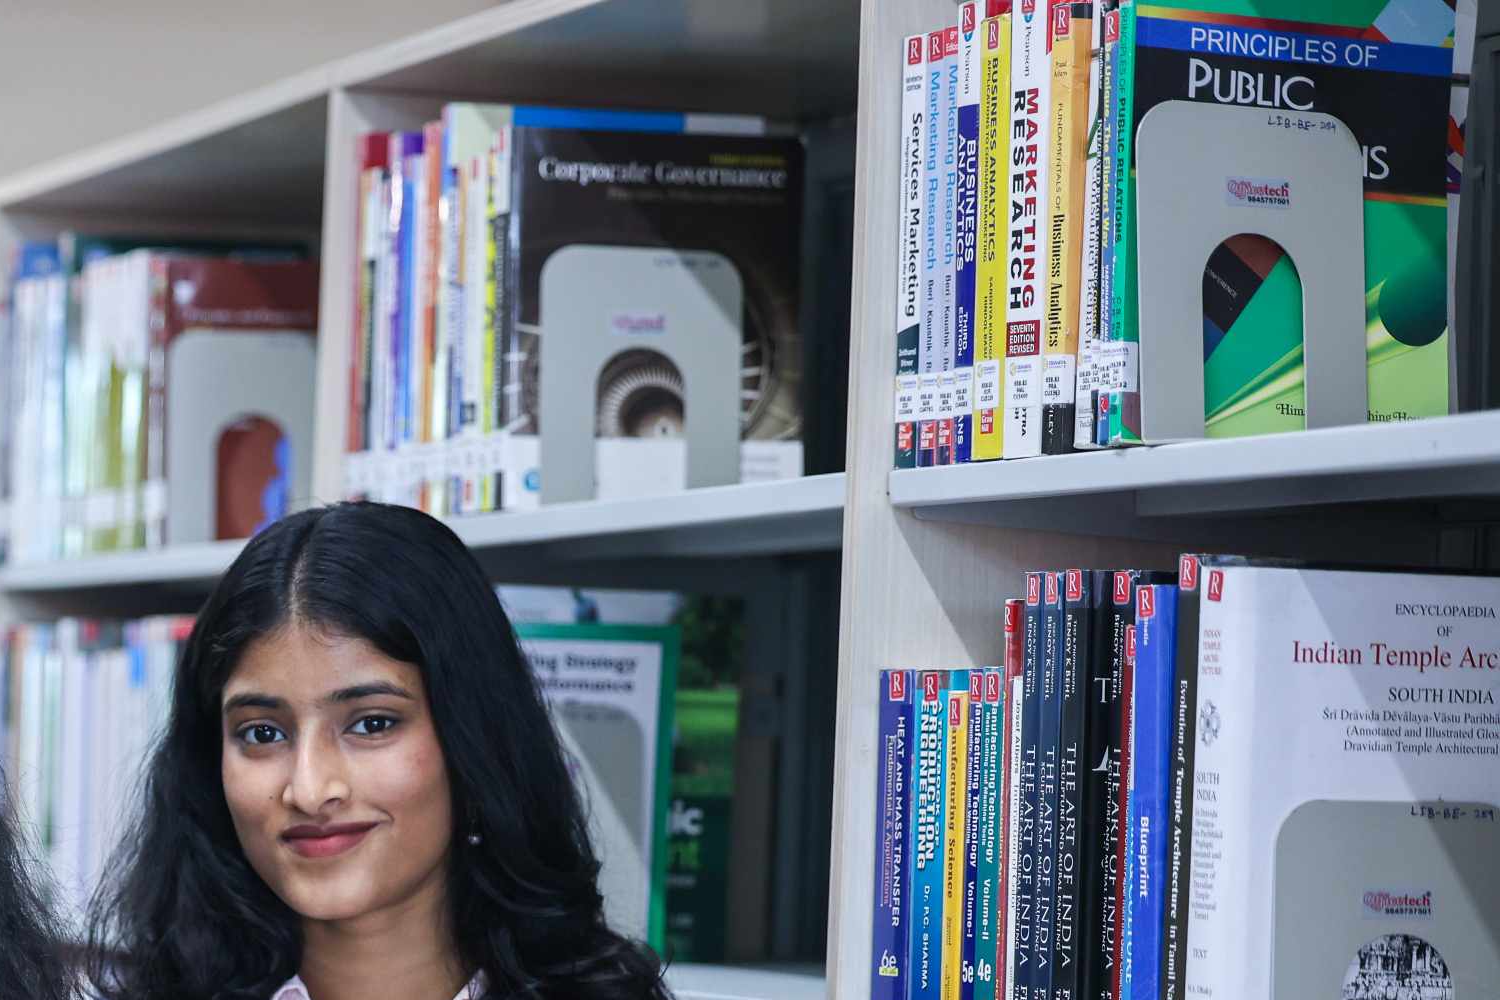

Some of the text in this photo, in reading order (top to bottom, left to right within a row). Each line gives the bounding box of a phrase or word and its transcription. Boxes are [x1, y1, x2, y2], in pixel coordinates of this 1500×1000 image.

[1024, 26, 1032, 77] Pearson
[1190, 27, 1379, 67] PRINCIPLES OF
[945, 64, 958, 164] Marketing
[1188, 57, 1315, 111] PUBLIC
[927, 72, 941, 170] Marketing
[538, 155, 652, 187] Corporate
[655, 162, 788, 189] Governance
[988, 57, 999, 262] BUSINESS ANALYTICS
[1115, 97, 1127, 243] PUBLIC RELATIONS
[905, 112, 923, 317] Services Marketing
[927, 177, 939, 269] Research
[944, 172, 956, 264] Research
[956, 133, 967, 271] ANALYTICS
[965, 139, 977, 262] BUSINESS
[1010, 90, 1026, 309] RESEARCH
[1022, 88, 1039, 308] MARKETING
[1051, 214, 1066, 277] Business
[1010, 323, 1035, 334] SEVENTH
[1010, 333, 1035, 345] EDITION
[1048, 282, 1063, 347] Analytics
[1010, 344, 1035, 354] REVISED
[1140, 589, 1150, 610] R
[1210, 573, 1220, 595] R
[1395, 603, 1496, 618] ENCYCLOPAEDIA
[1045, 615, 1053, 655] BENOY
[1064, 613, 1073, 701] BENOY BEHL
[1293, 640, 1500, 673] Indian Temple Arc
[1436, 625, 1453, 637] OF
[1177, 679, 1189, 744] Evolution
[1388, 686, 1495, 704] SOUTH INDIA
[1177, 747, 1185, 763] of
[1344, 739, 1499, 756] Dravidian Temple Architectural
[1346, 725, 1474, 739] (Annotated and Illustrated
[917, 702, 931, 869] ENGINEERING
[925, 701, 940, 860] PRODUCTION
[1173, 766, 1185, 823] Temple
[882, 735, 897, 905] Fundamentals Applications
[891, 716, 906, 927] HEAT AND MASS TRANSFER
[947, 838, 956, 899] Science
[978, 792, 997, 983] Technology Volume-II 4e
[1019, 744, 1036, 968] THE ART OF INDIA
[1038, 745, 1055, 969] THE ART OF INDIA
[1061, 743, 1077, 969] THE ART OF INDIA
[1137, 816, 1150, 898] Blueprint
[1170, 826, 1182, 918] Architecture
[962, 796, 980, 984] Technology Volume-I 5e
[881, 949, 898, 969] 6e
[921, 933, 929, 990] SHARMA
[1167, 941, 1178, 980] Tamil
[1169, 925, 1178, 938] in
